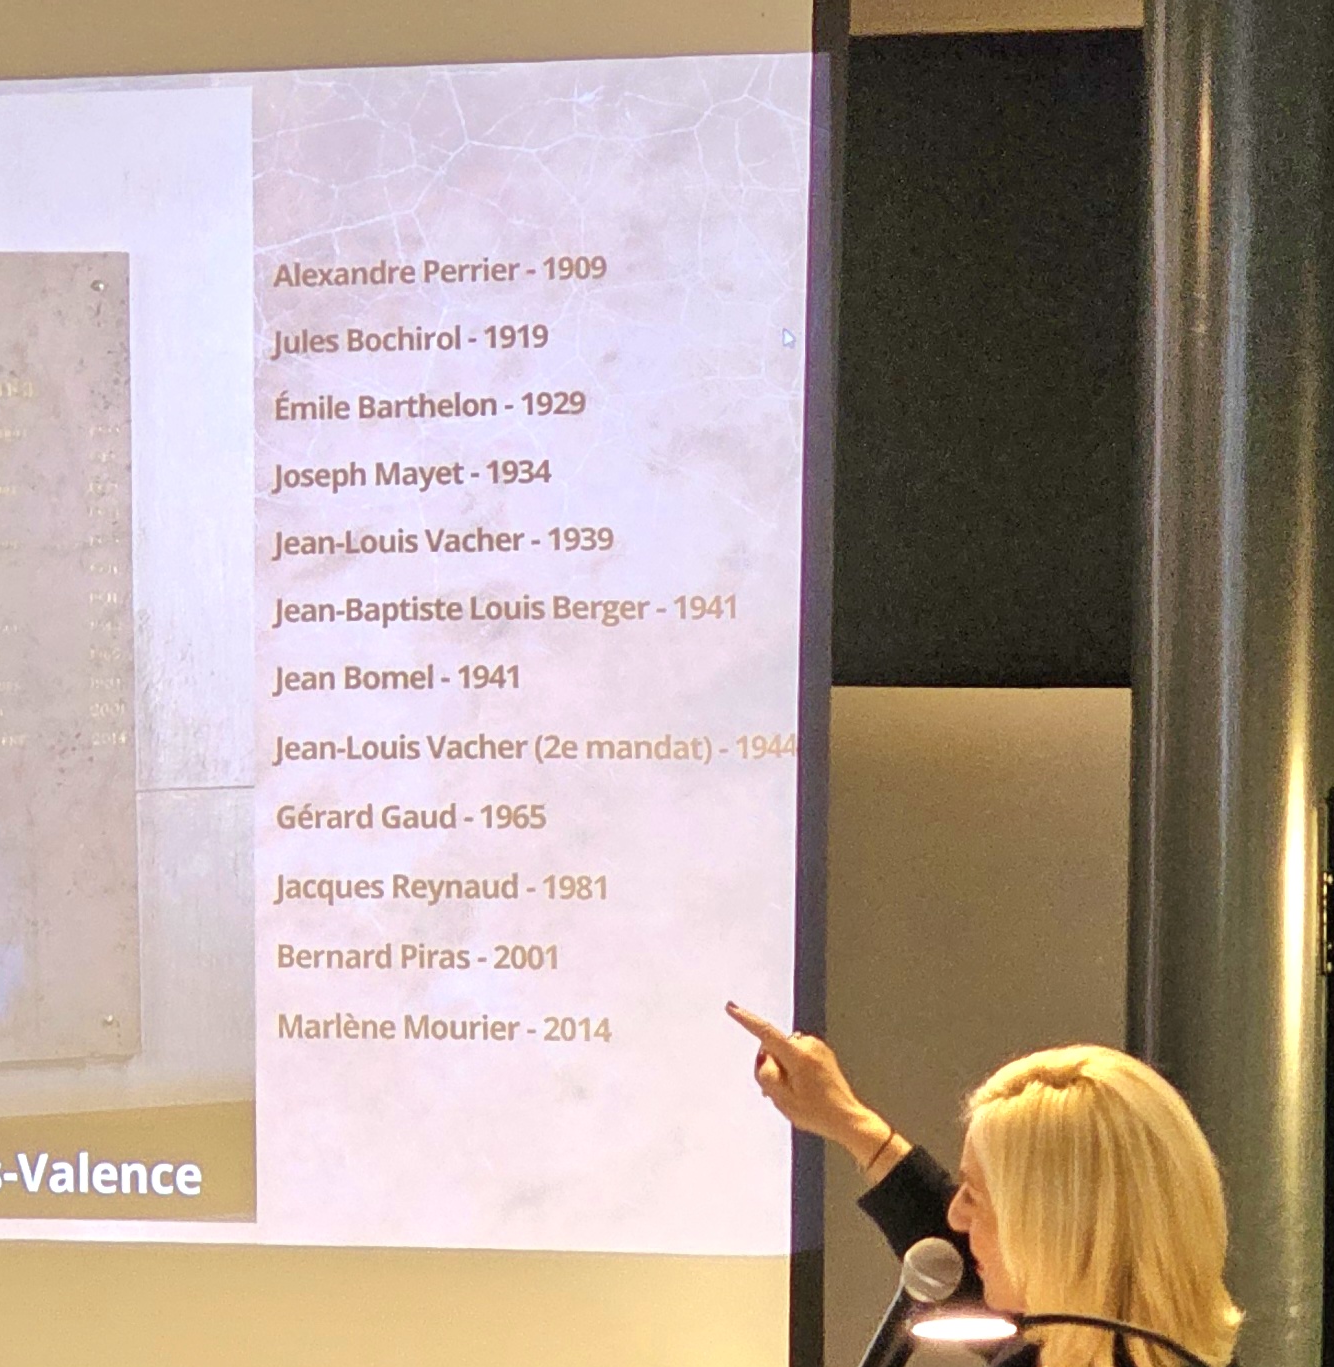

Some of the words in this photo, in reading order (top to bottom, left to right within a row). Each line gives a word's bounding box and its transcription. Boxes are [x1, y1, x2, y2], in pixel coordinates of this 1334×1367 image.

[273, 260, 415, 287] Alexandre
[424, 257, 520, 283] Perrier
[543, 256, 607, 280] 1909
[270, 329, 339, 361] Jules
[347, 325, 461, 352] Bochirol
[484, 324, 548, 349] 1919
[276, 390, 350, 420] Émile
[359, 392, 497, 419] Barthelon
[522, 391, 586, 416] 1929
[271, 462, 366, 494] Joseph
[376, 462, 464, 492] Mayet
[487, 460, 552, 484] 1934
[272, 528, 418, 561] Jean-Louis
[425, 527, 525, 552] Vacher
[548, 527, 614, 552] 1939
[272, 596, 463, 629] Jean-Baptiste
[471, 594, 545, 620] Louis
[553, 596, 650, 627] Berger
[674, 594, 735, 620] 1941
[272, 667, 335, 697] Jean
[345, 664, 433, 690] Bomel
[458, 665, 519, 689] 1941
[272, 734, 420, 766] Jean-Louis
[426, 733, 528, 759] Vacher
[535, 735, 578, 764] (2e
[587, 734, 712, 765] mandat)
[735, 733, 796, 760] 1944
[277, 803, 373, 829] Gérard
[382, 803, 456, 829] Gaud
[481, 804, 546, 829] 1965
[273, 875, 384, 906] Jacques
[393, 872, 518, 906] Reynaud
[543, 874, 606, 900] 1981
[278, 943, 392, 969] Bernard
[402, 943, 470, 969] Piras
[494, 945, 557, 970] 2001
[279, 1013, 396, 1040] Marlène
[405, 1014, 520, 1041] Mourier
[544, 1017, 612, 1042] 2014
